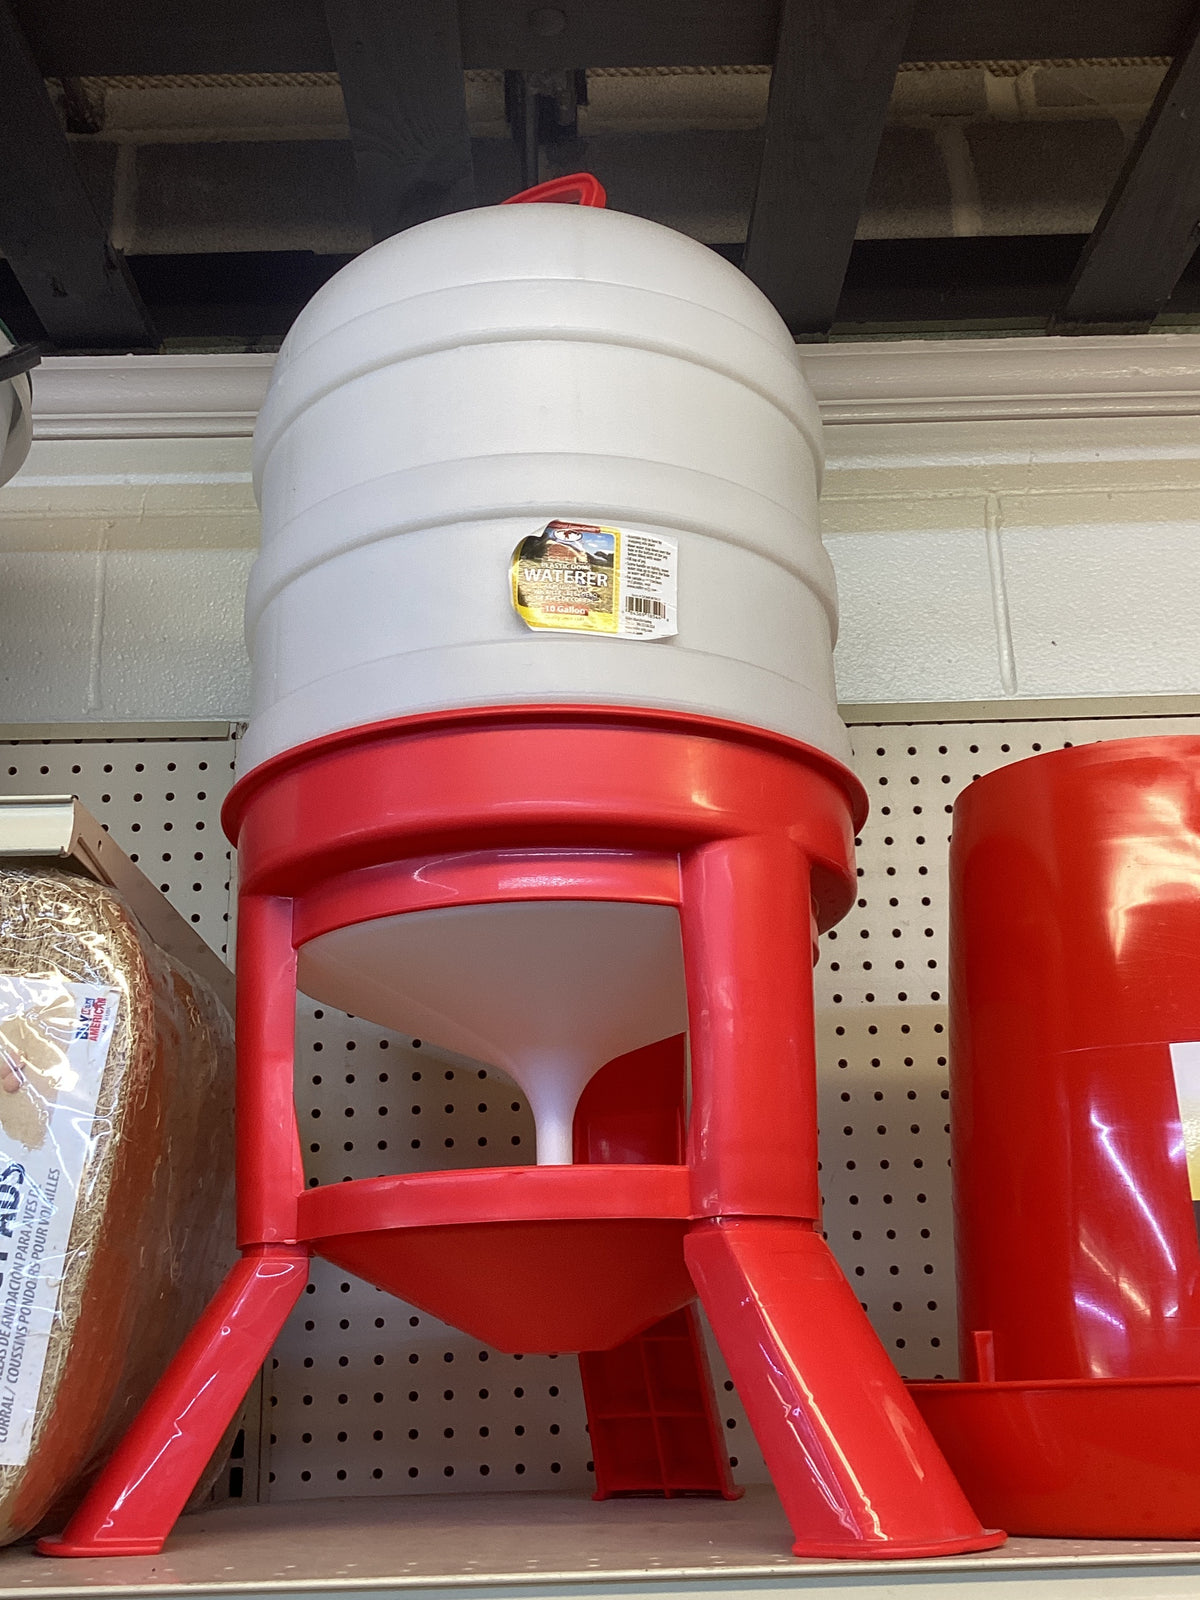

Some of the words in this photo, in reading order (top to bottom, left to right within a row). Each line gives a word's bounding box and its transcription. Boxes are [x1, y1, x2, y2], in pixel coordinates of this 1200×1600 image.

[523, 568, 608, 587] WATERER
[545, 604, 555, 613] 10
[557, 605, 586, 615] Gallon
[89, 997, 107, 1042] AMERICAN
[0, 1163, 25, 1261] ADS
[23, 1198, 38, 1229] AVES
[15, 1229, 32, 1262] PARA
[7, 1325, 28, 1384] COUSSINS
[31, 1227, 49, 1260] POUR
